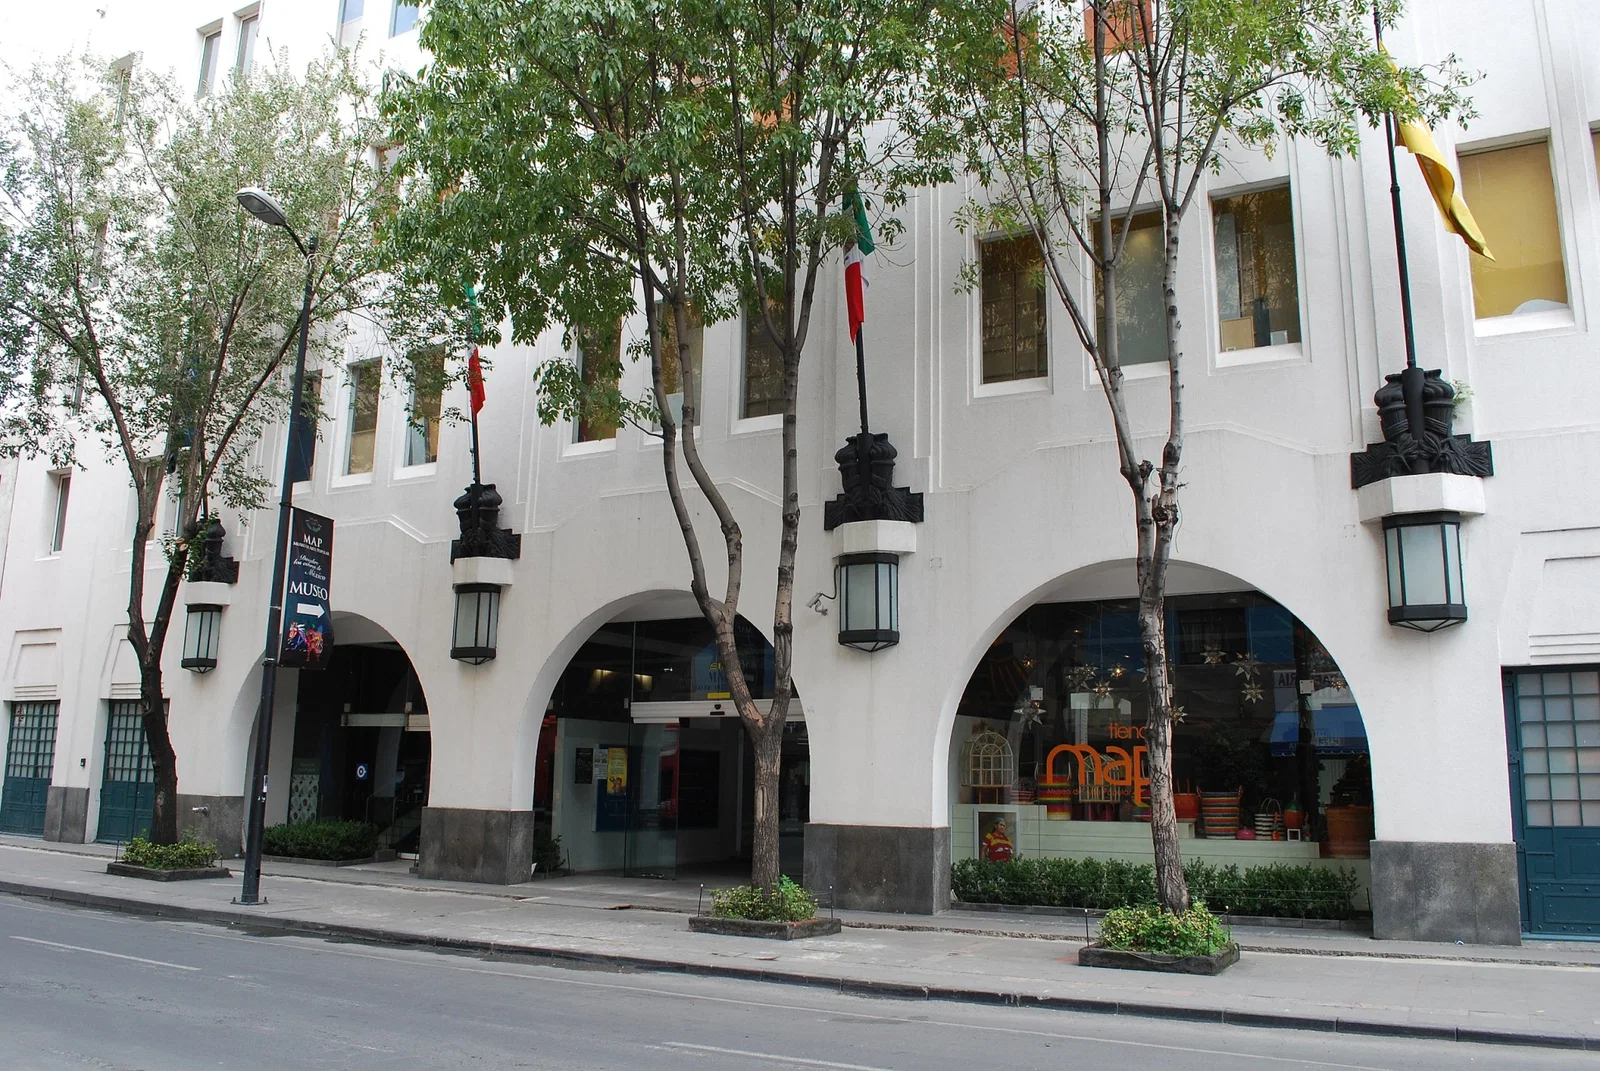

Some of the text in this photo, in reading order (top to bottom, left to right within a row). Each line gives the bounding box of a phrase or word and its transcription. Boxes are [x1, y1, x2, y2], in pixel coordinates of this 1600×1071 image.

[303, 533, 323, 548] MAP
[289, 580, 328, 601] MUSEO
[1109, 721, 1147, 740] tien
[1046, 743, 1151, 804] map
